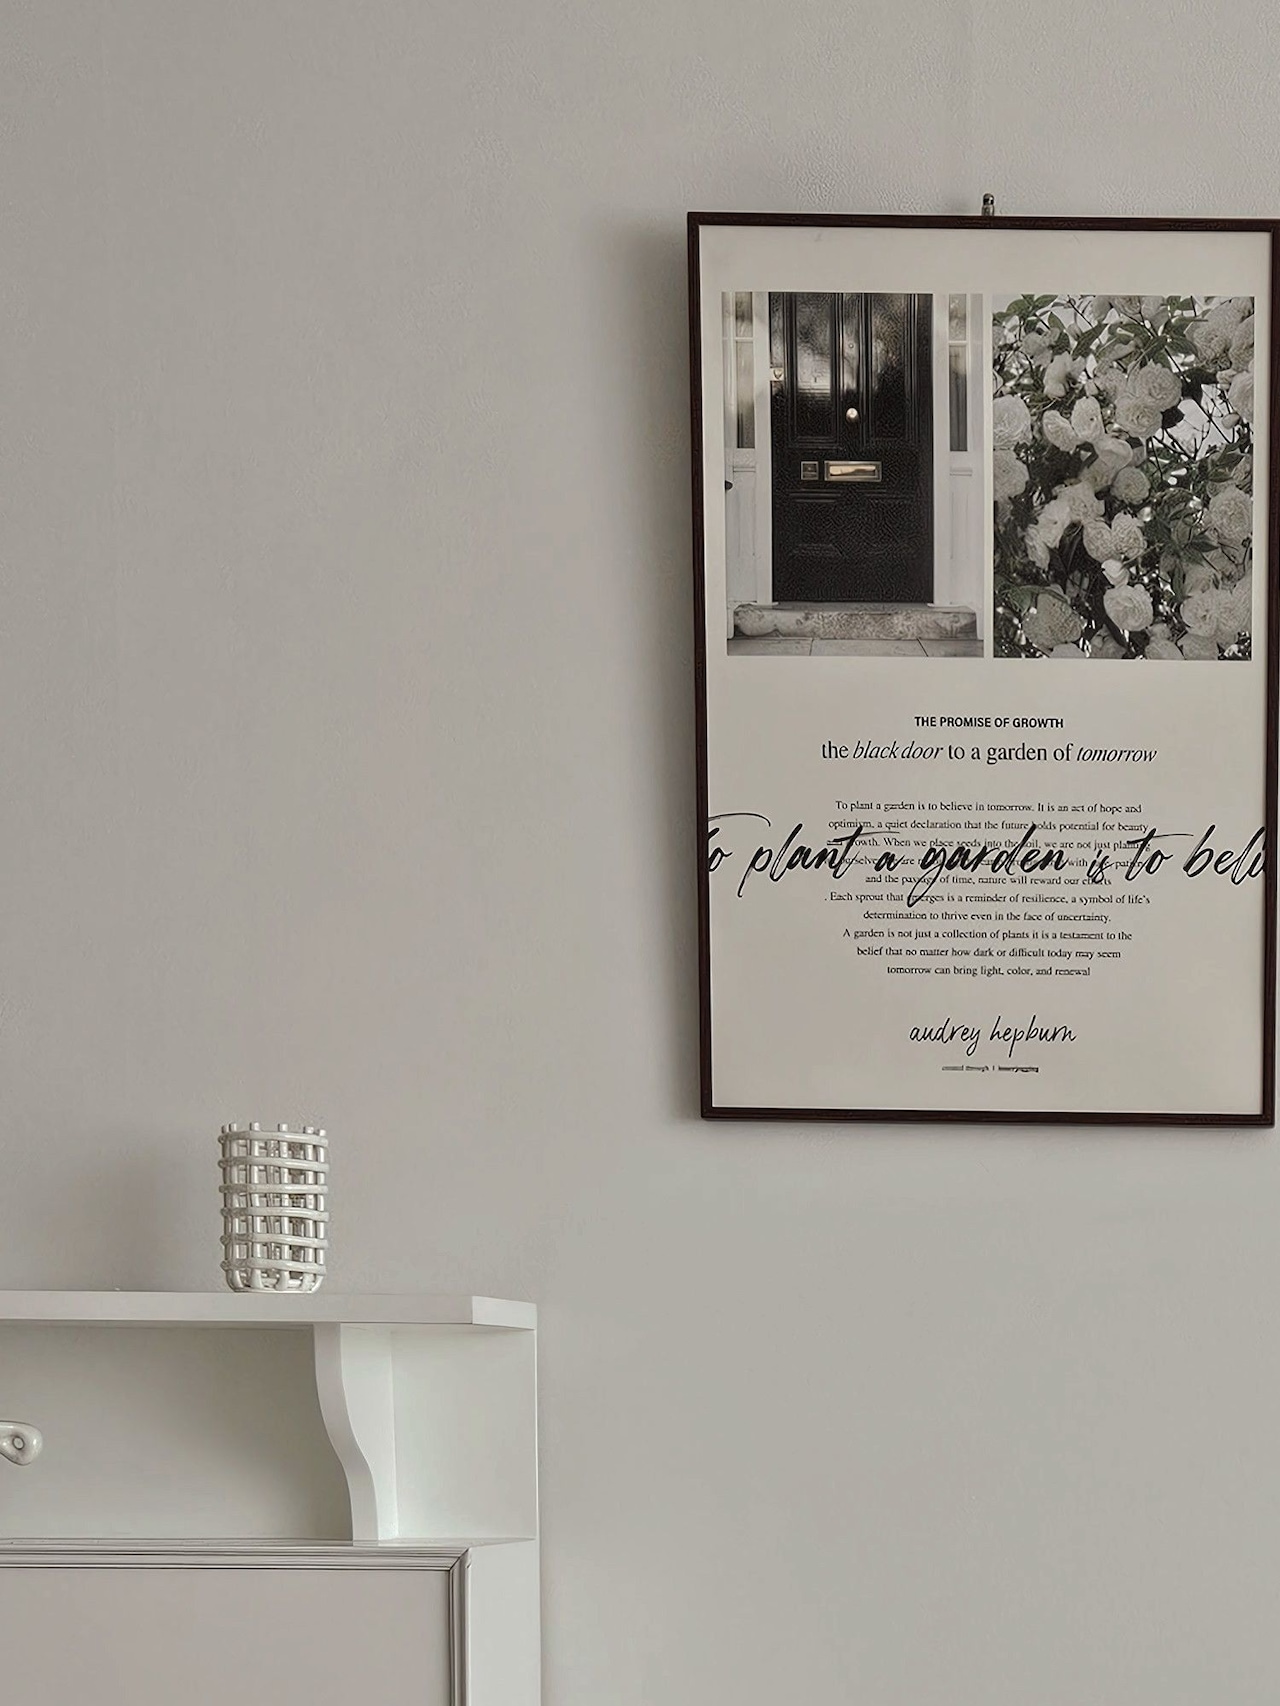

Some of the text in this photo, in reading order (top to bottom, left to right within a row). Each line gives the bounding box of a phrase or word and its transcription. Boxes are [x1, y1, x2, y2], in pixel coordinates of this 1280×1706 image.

[914, 716, 1064, 728] THE PROMISE OF GROWTH
[822, 740, 1158, 765] the black door to a garden of tomorrow
[835, 801, 848, 809] To
[851, 801, 873, 812] plant
[884, 801, 915, 812] garden
[918, 801, 925, 810] is
[940, 802, 972, 811] believe
[976, 802, 984, 811] in
[1038, 803, 1044, 812] It
[1048, 803, 1055, 811] is
[1087, 804, 1097, 812] of
[1100, 804, 1122, 815] hope
[1125, 804, 1142, 813] and
[885, 819, 908, 831] quiet
[910, 820, 961, 828] declaration
[964, 821, 981, 829] that
[985, 821, 998, 829] the
[1002, 821, 1029, 831] future
[1059, 822, 1099, 832] potential
[1102, 821, 1115, 830] for
[1118, 823, 1148, 835] beauty
[883, 837, 910, 847] When
[913, 840, 927, 848] we
[930, 838, 953, 849] place
[1044, 841, 1057, 849] we
[1060, 841, 1074, 849] are
[1077, 840, 1091, 849] not
[1094, 840, 1110, 852] just
[737, 823, 861, 898] plant
[874, 851, 905, 872] a
[906, 824, 1068, 908] garden
[1087, 850, 1115, 884] is
[865, 874, 882, 883] and
[885, 874, 899, 883] the
[939, 874, 949, 884] of
[952, 875, 976, 885] time,
[1010, 876, 1027, 885] will
[1030, 876, 1062, 886] reward
[831, 892, 852, 900] Each
[855, 894, 883, 903] sprout
[887, 893, 903, 901] that
[947, 893, 955, 901] is
[965, 893, 1007, 902] reminder
[1009, 894, 1019, 902] of
[1022, 894, 1069, 903] resilience,
[1079, 895, 1113, 905] symbol
[1116, 895, 1126, 903] of
[863, 911, 927, 919] determination
[942, 911, 968, 920] thrive
[995, 912, 1004, 920] in
[1007, 912, 1020, 920] the
[1023, 912, 1042, 921] face
[1045, 912, 1055, 921] of
[1057, 913, 1112, 924] uncertainty.
[843, 929, 850, 937] A
[854, 929, 884, 939] garden
[888, 929, 895, 937] is
[914, 929, 931, 940] just
[942, 929, 987, 938] collection
[990, 930, 1000, 938] of
[1002, 930, 1029, 941] plants
[1032, 930, 1038, 939] it
[1042, 930, 1049, 939] is
[1118, 932, 1133, 940] the
[857, 946, 883, 955] belief
[886, 947, 902, 955] that
[952, 948, 971, 956] how
[973, 948, 994, 957] dark
[1009, 948, 1045, 957] difficult
[1048, 949, 1072, 960] today
[1075, 951, 1094, 960] may
[953, 966, 978, 977] bring
[981, 965, 1004, 977] light,
[1007, 966, 1034, 976] color,
[1036, 967, 1052, 975] and
[1055, 967, 1091, 976] renewal
[910, 1014, 1077, 1058] audrey hepburn
